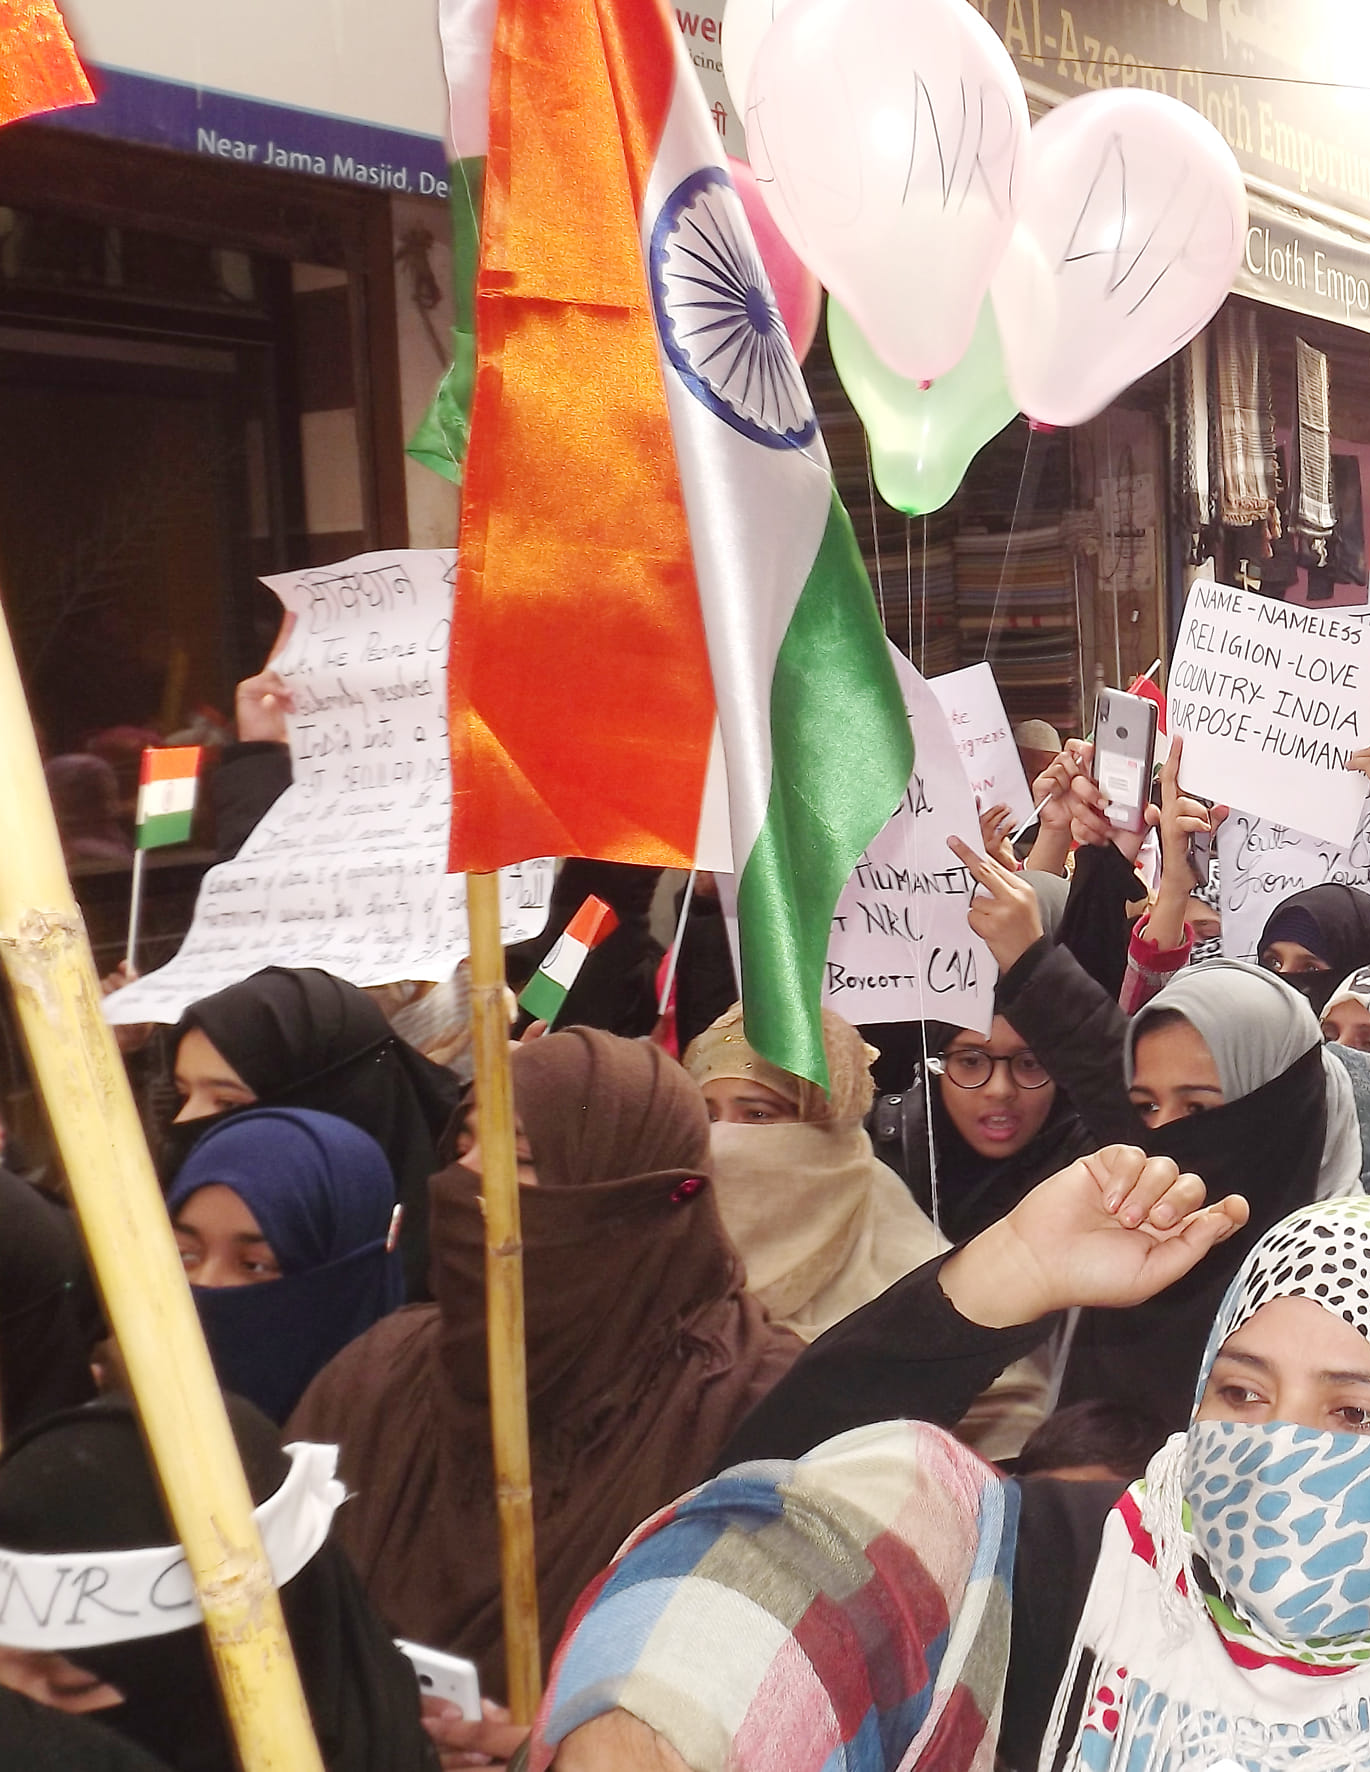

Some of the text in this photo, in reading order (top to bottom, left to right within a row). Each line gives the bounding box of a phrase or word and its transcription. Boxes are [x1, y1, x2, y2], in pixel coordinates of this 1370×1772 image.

[676, 8, 722, 45] we
[196, 127, 450, 198] Near Jama Masjid, De
[1244, 226, 1306, 290] Cloth
[856, 901, 924, 942] NRC
